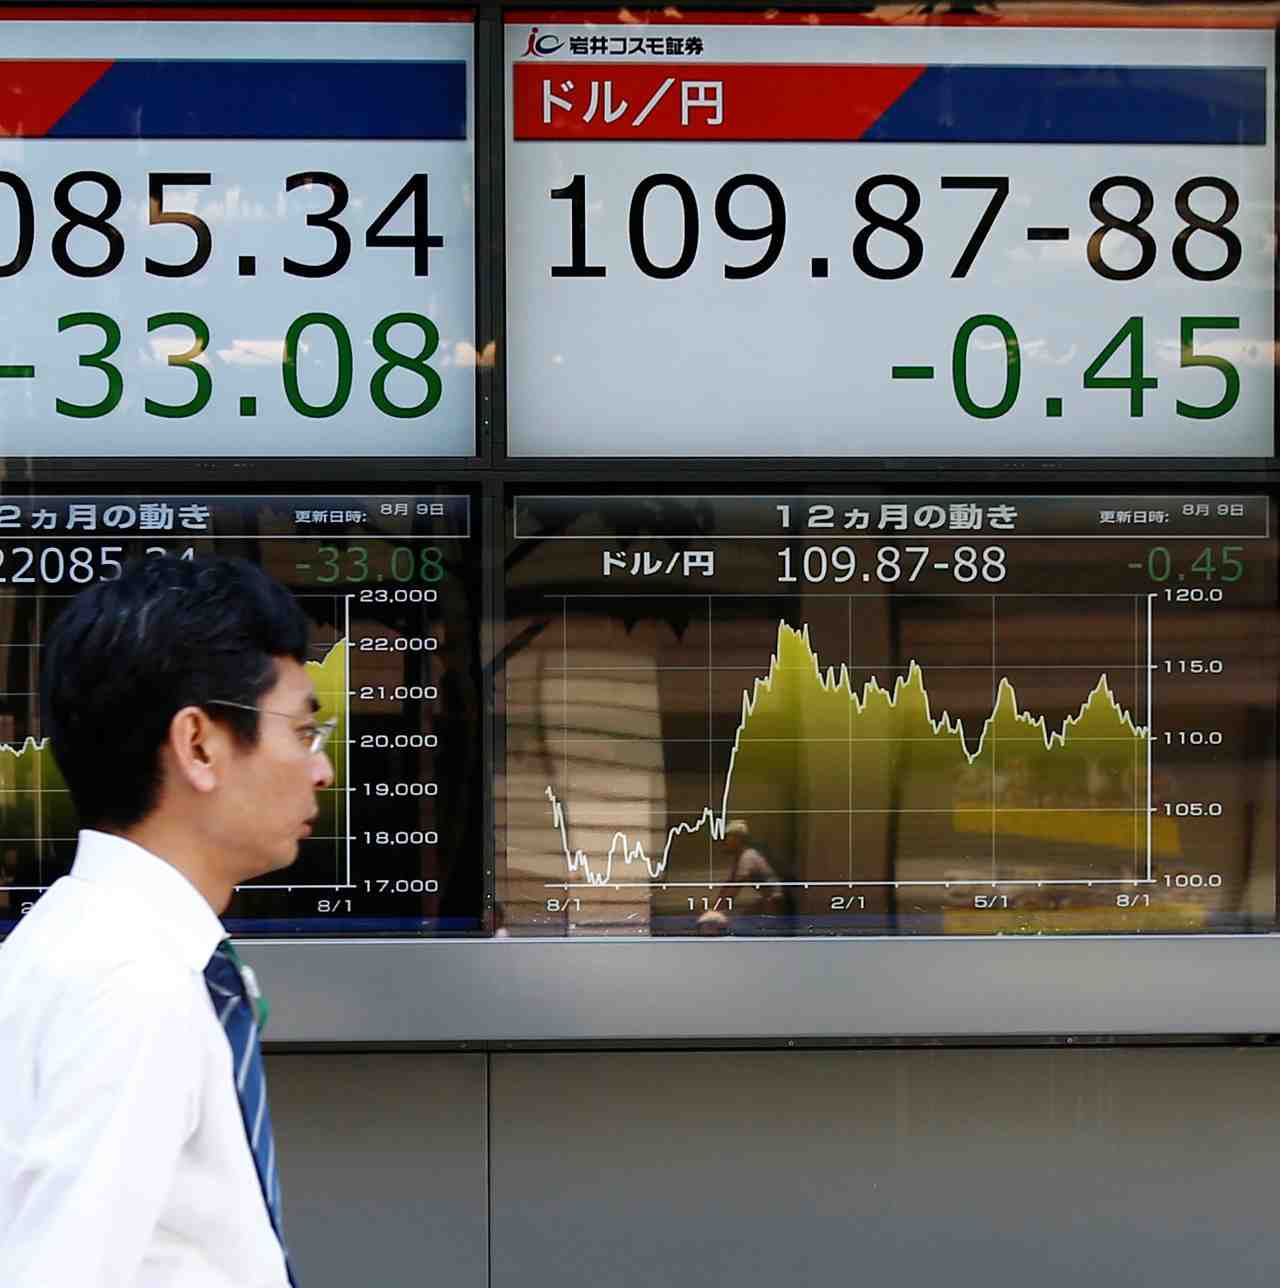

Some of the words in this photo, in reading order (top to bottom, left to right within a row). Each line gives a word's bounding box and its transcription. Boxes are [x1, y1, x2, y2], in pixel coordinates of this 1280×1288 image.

[570, 36, 704, 55] 岩井コスモ証券
[550, 173, 1242, 280] 109.87-88
[891, 314, 1242, 419] -0.45
[296, 546, 446, 583] -33.08
[601, 551, 715, 577] ドル/円
[776, 545, 1007, 583] 109.87-88
[1129, 546, 1245, 582] -0.45
[1164, 588, 1223, 602] 120.0
[1165, 660, 1223, 673] 115.0
[1164, 731, 1222, 745] 110.0
[1164, 803, 1222, 816] 105.0
[1164, 874, 1222, 888] 100.0
[317, 899, 352, 913] 8/1
[547, 898, 581, 912] 8/1
[687, 897, 732, 911] 11/1
[831, 896, 865, 909] 2/1
[974, 895, 1008, 908] 5/1
[1116, 894, 1150, 907] 8/1
